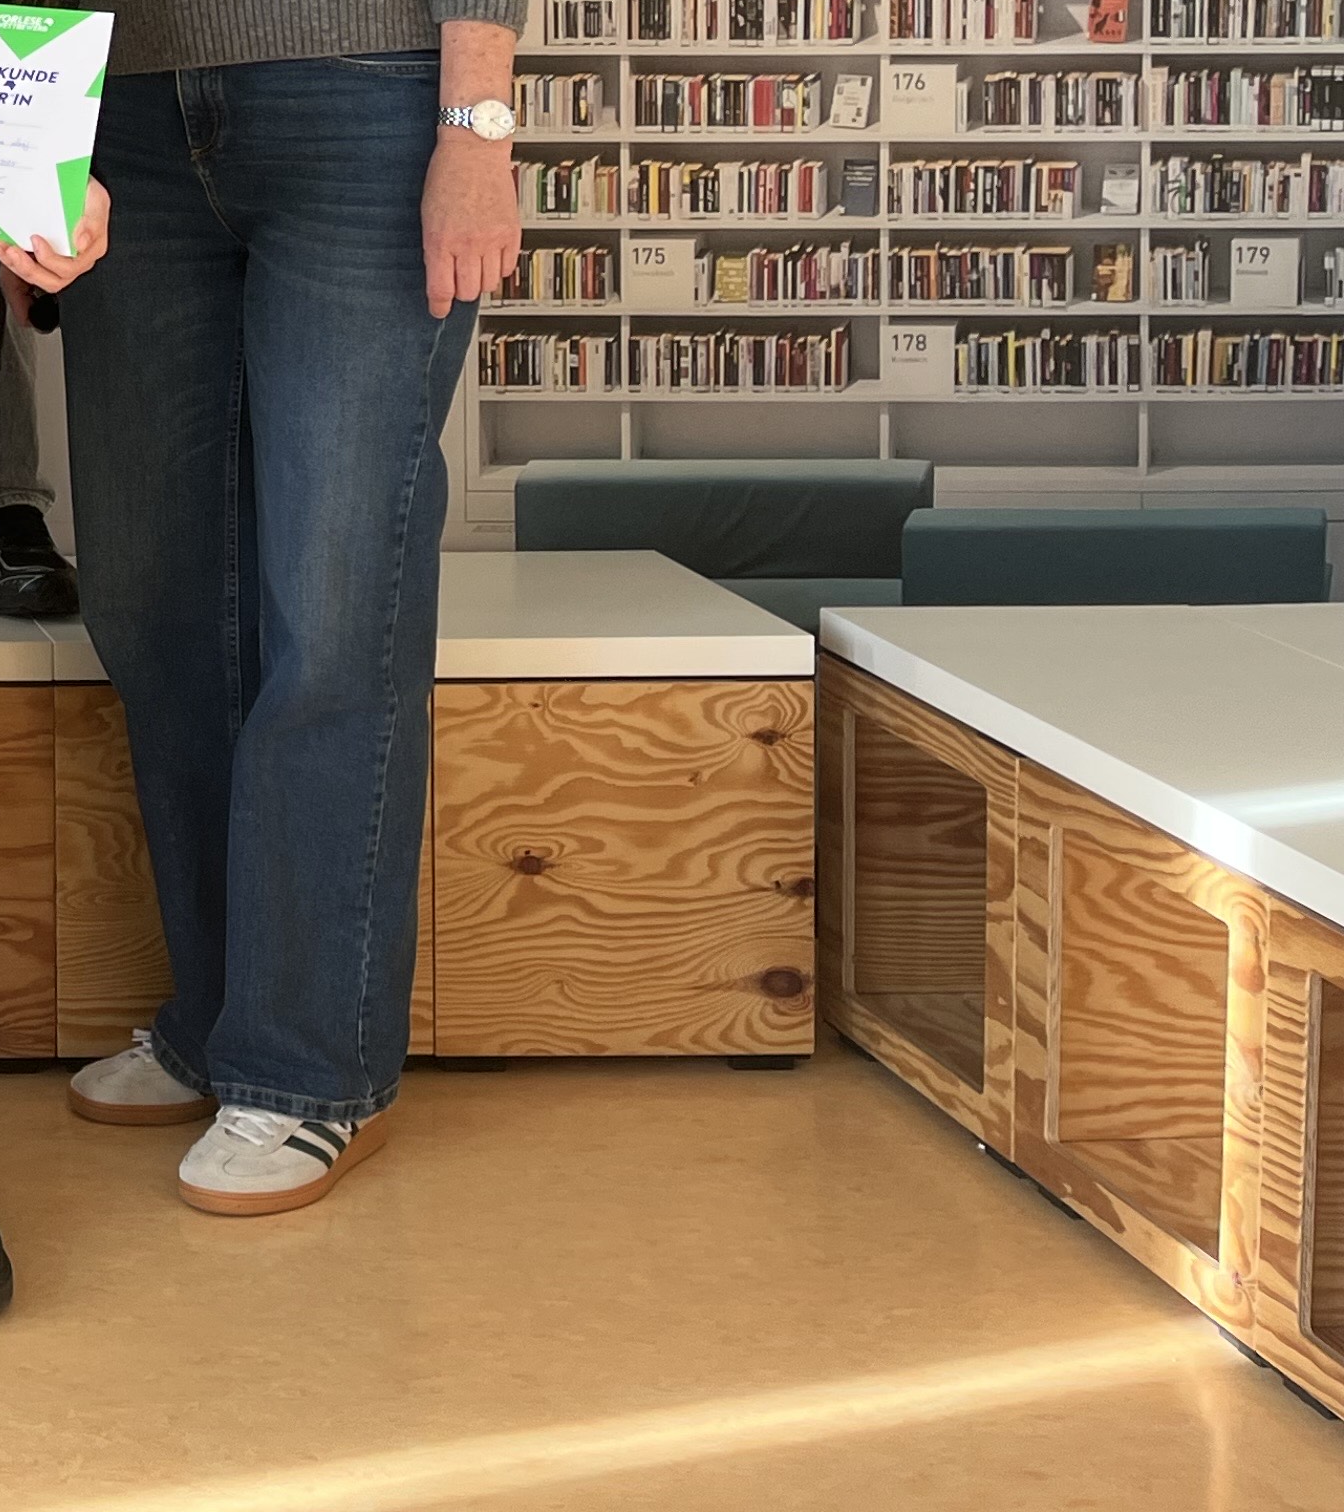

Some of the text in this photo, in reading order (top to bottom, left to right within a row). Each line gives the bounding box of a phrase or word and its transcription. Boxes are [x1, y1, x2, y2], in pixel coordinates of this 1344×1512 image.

[892, 72, 926, 90] 176
[632, 247, 666, 265] 175
[1236, 246, 1270, 264] 179
[892, 333, 927, 351] 178
